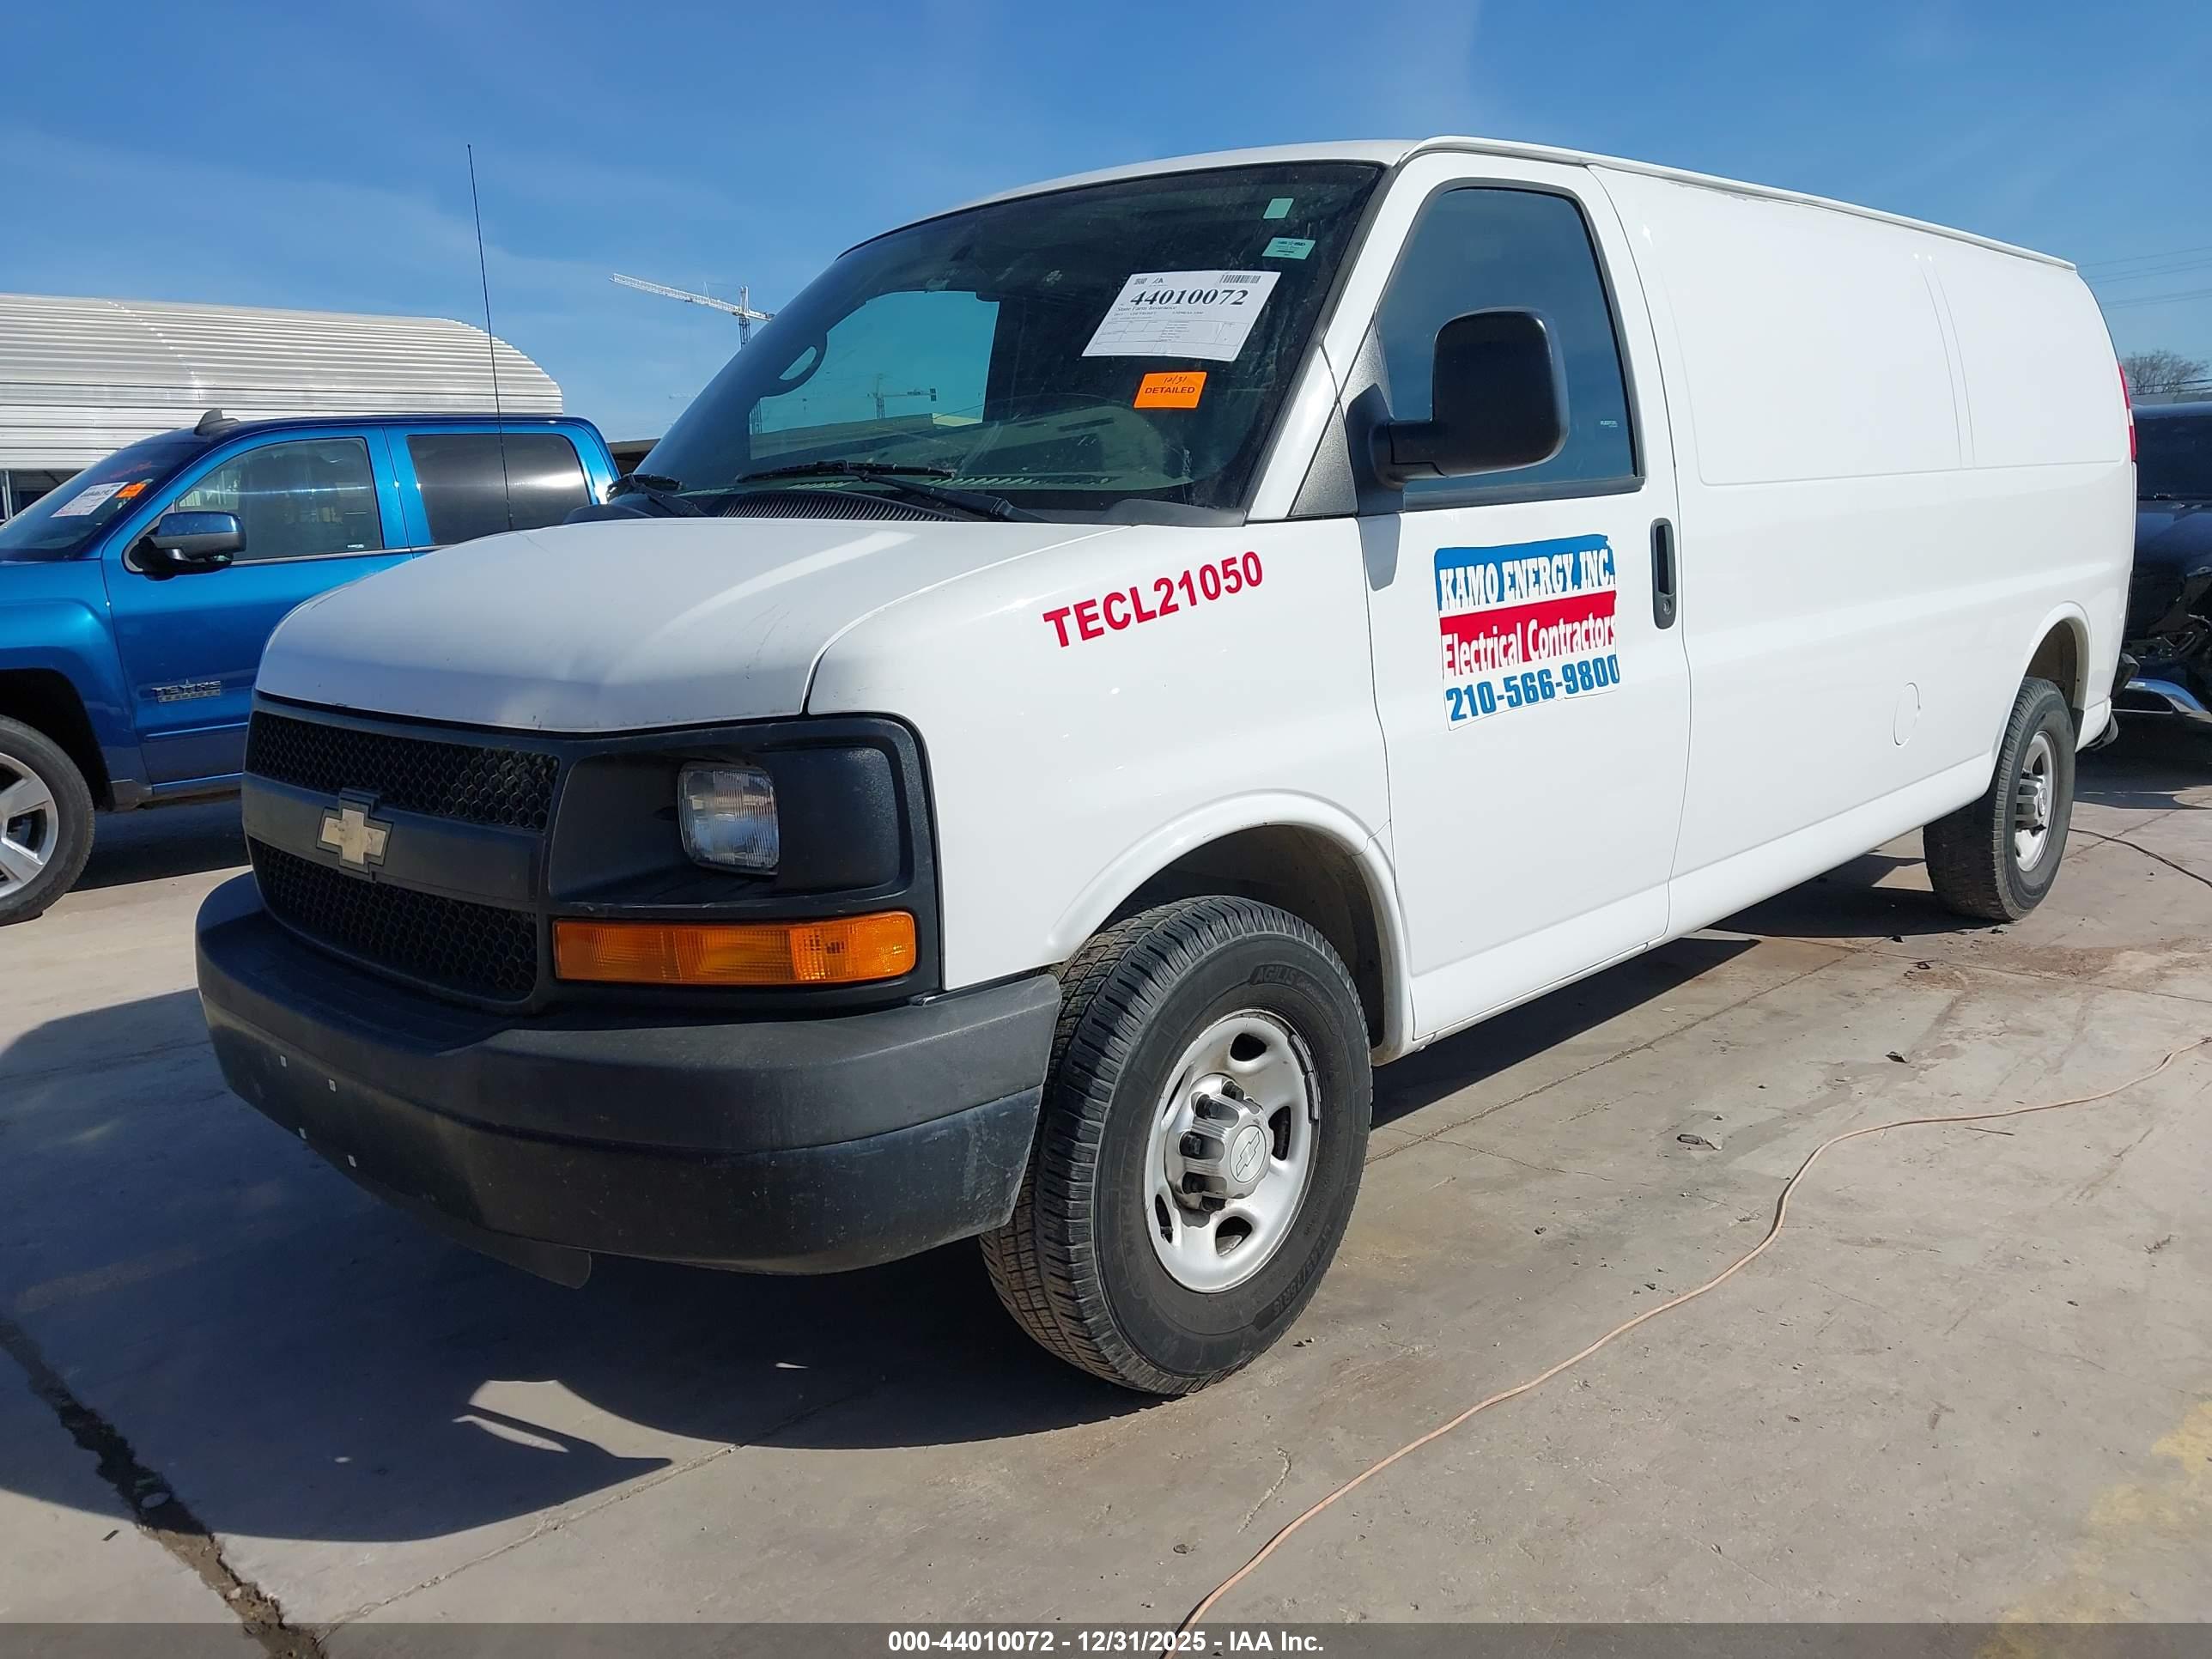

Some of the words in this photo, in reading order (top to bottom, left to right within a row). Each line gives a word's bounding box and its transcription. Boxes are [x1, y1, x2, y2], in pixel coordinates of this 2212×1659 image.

[1130, 289, 1249, 305] 44010072
[1164, 375, 1188, 385] 12/31
[1042, 551, 1262, 647] TECL21050
[1439, 562, 1499, 611] KAMO
[1579, 549, 1615, 586] INC.
[1442, 622, 1522, 676] Electrical
[1527, 612, 1616, 660] Contractors
[1445, 654, 1620, 721] 210-566-9800
